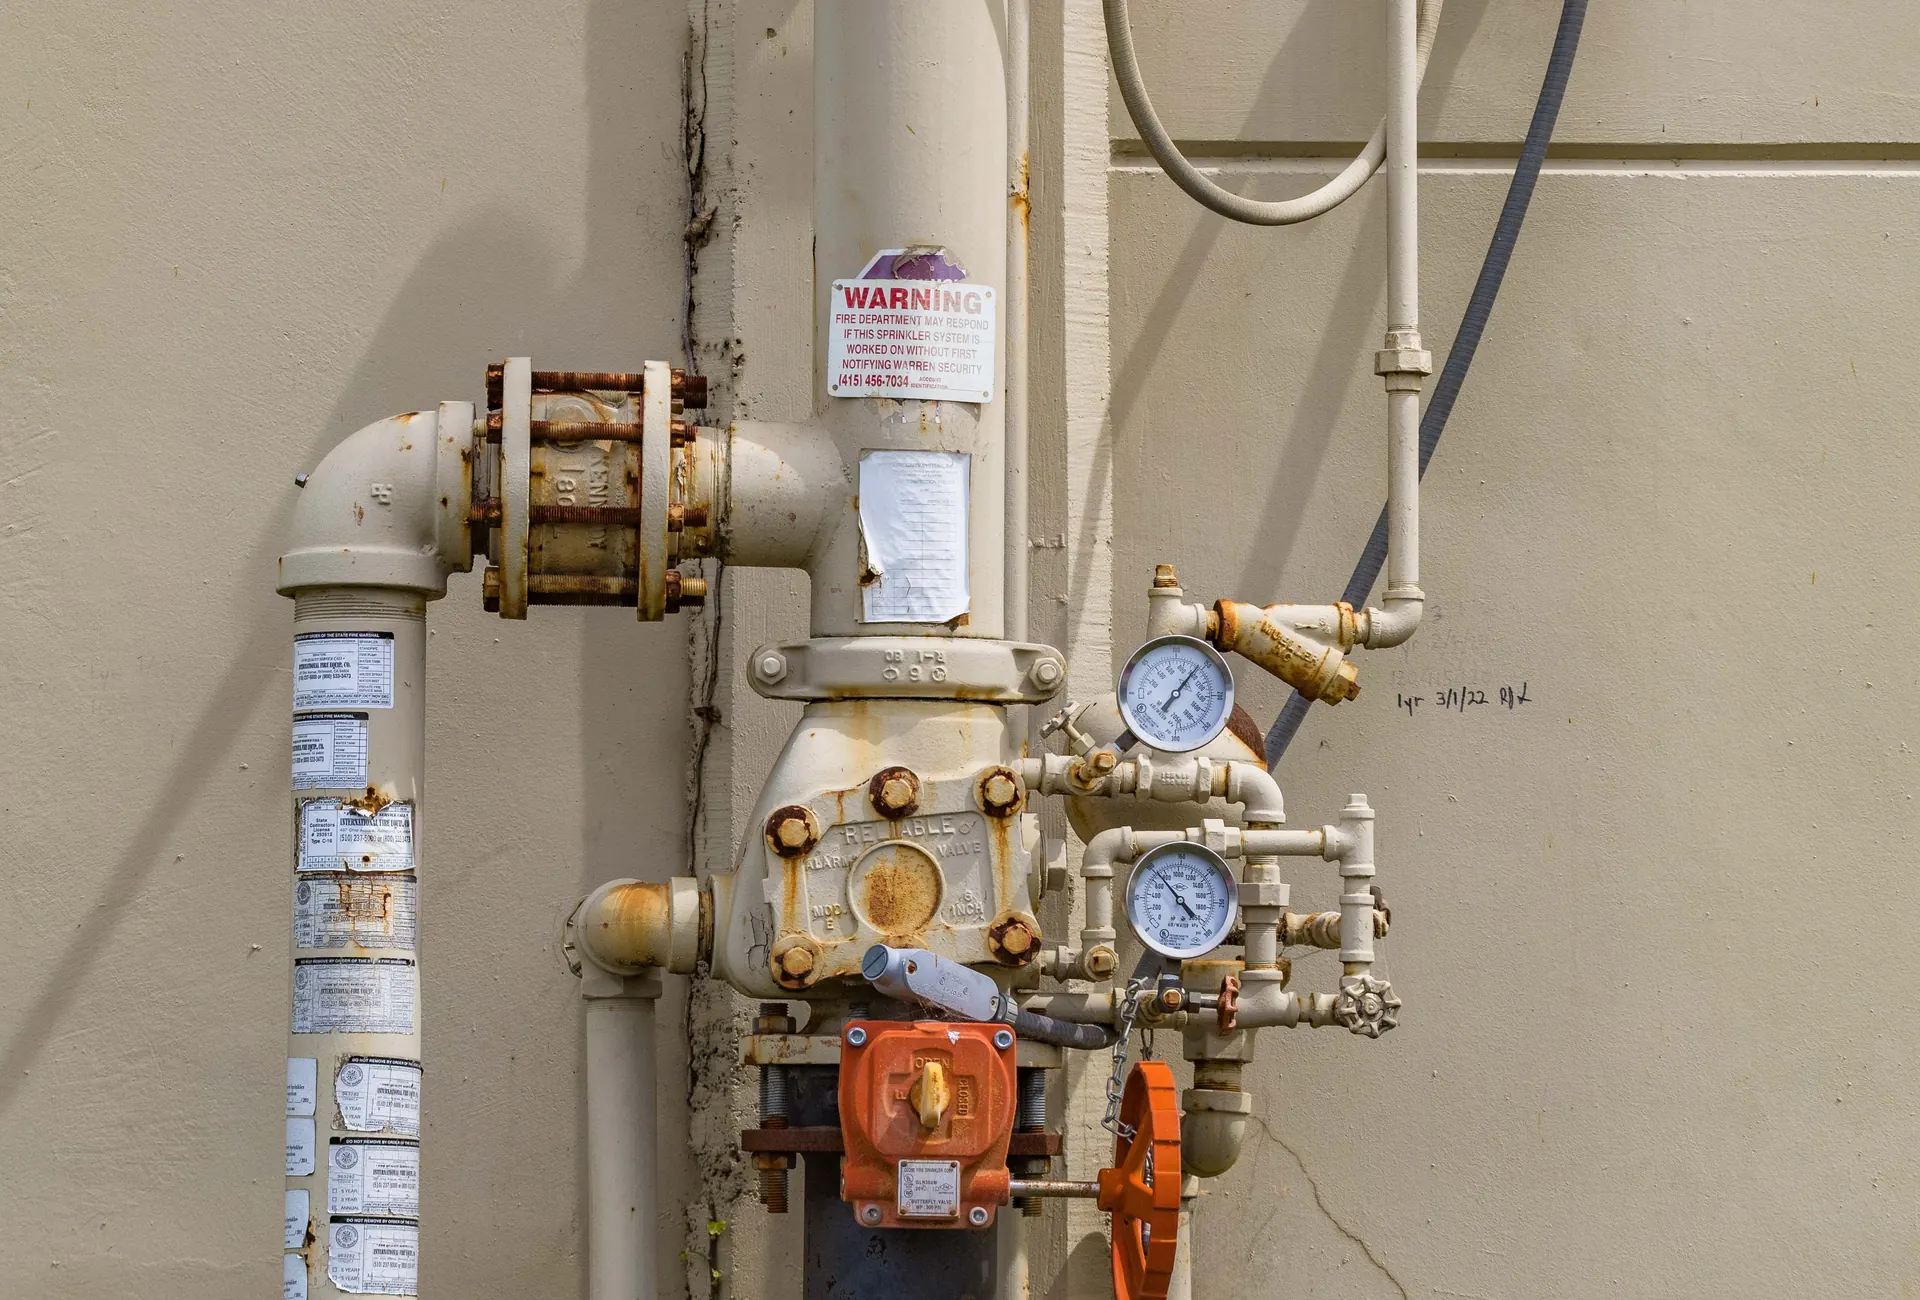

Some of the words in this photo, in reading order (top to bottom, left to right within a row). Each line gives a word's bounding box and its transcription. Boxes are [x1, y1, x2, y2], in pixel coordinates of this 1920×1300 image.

[844, 287, 982, 314] WARNING
[836, 314, 856, 324] FIRE
[859, 314, 922, 325] DEPARTMENT
[925, 317, 943, 327] MAY
[947, 318, 988, 330] RESPOND
[844, 329, 854, 338] IF
[855, 329, 874, 339] THIS
[877, 330, 930, 341] SPRINKLER
[934, 332, 969, 344] SYSTEM
[972, 335, 980, 344] IS
[847, 344, 887, 354] WORKED
[890, 345, 904, 355] ON
[906, 345, 949, 358] WITHOUT
[952, 348, 977, 359] FIRST
[842, 360, 891, 370] NOTIFYING
[894, 361, 935, 371] WARREN
[938, 362, 982, 374] SECURITY
[839, 374, 862, 386] (415)
[865, 375, 909, 387] 456-7034
[1177, 665, 1186, 674] 800
[1204, 660, 1212, 668] 150
[1157, 670, 1166, 679] 400
[1165, 667, 1175, 675] 600
[1149, 679, 1158, 688] 200
[1195, 681, 1205, 691] 1200
[1196, 692, 1206, 702] 1400
[1436, 686, 1489, 712] 3/1/22
[1190, 701, 1201, 711] 1600
[1170, 713, 1182, 724] 2050
[1183, 709, 1193, 720] 1800
[1202, 722, 1211, 731] 250
[340, 818, 378, 826] INTERNATIONAL
[844, 817, 956, 844] RELIABLE
[937, 841, 982, 857] VALVE
[805, 855, 853, 870] ALARM
[1206, 867, 1215, 876] 200
[951, 901, 985, 916] INCH
[1204, 929, 1212, 938] 300
[958, 1078, 968, 1116] CLOSED
